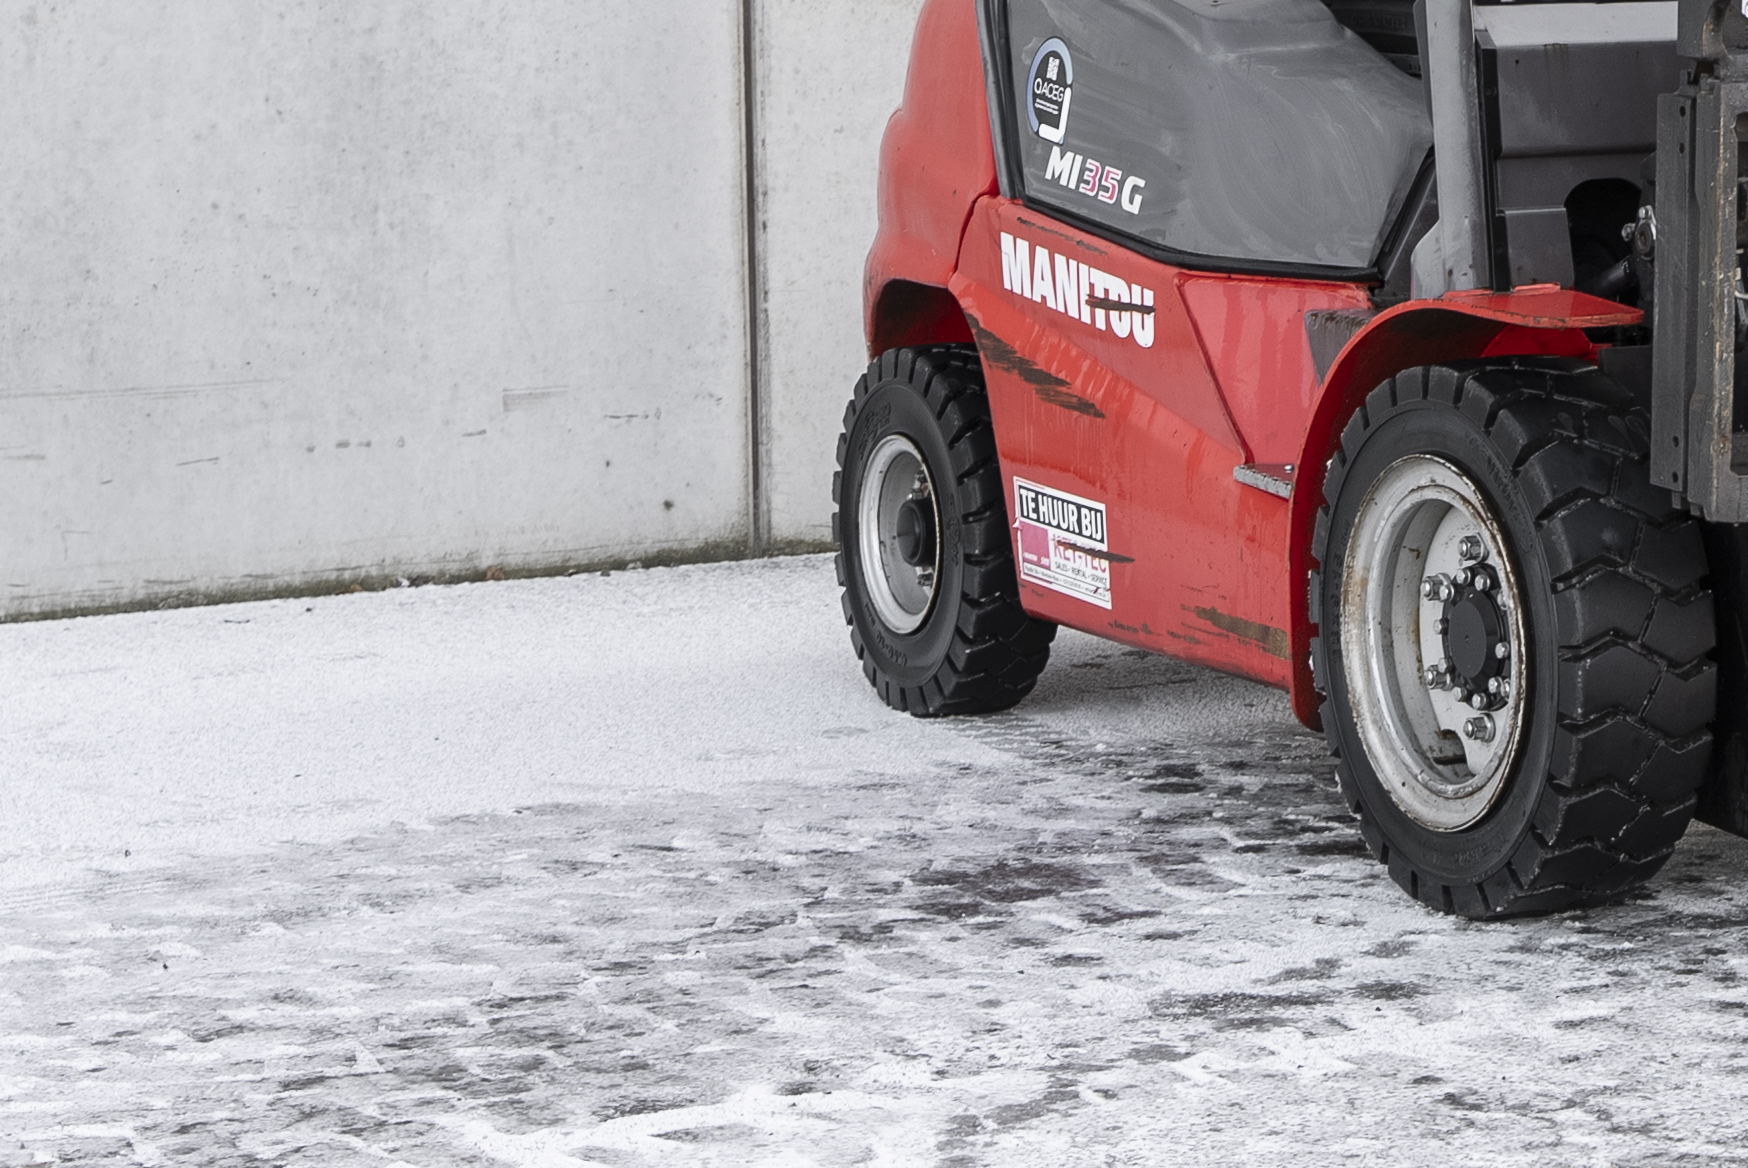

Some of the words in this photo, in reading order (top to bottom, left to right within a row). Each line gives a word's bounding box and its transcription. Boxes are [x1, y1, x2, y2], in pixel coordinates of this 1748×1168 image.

[1001, 232, 1155, 348] MANITOU
[1020, 488, 1037, 520] TE
[1038, 494, 1079, 533] HUUR
[1081, 507, 1102, 540] BIJ
